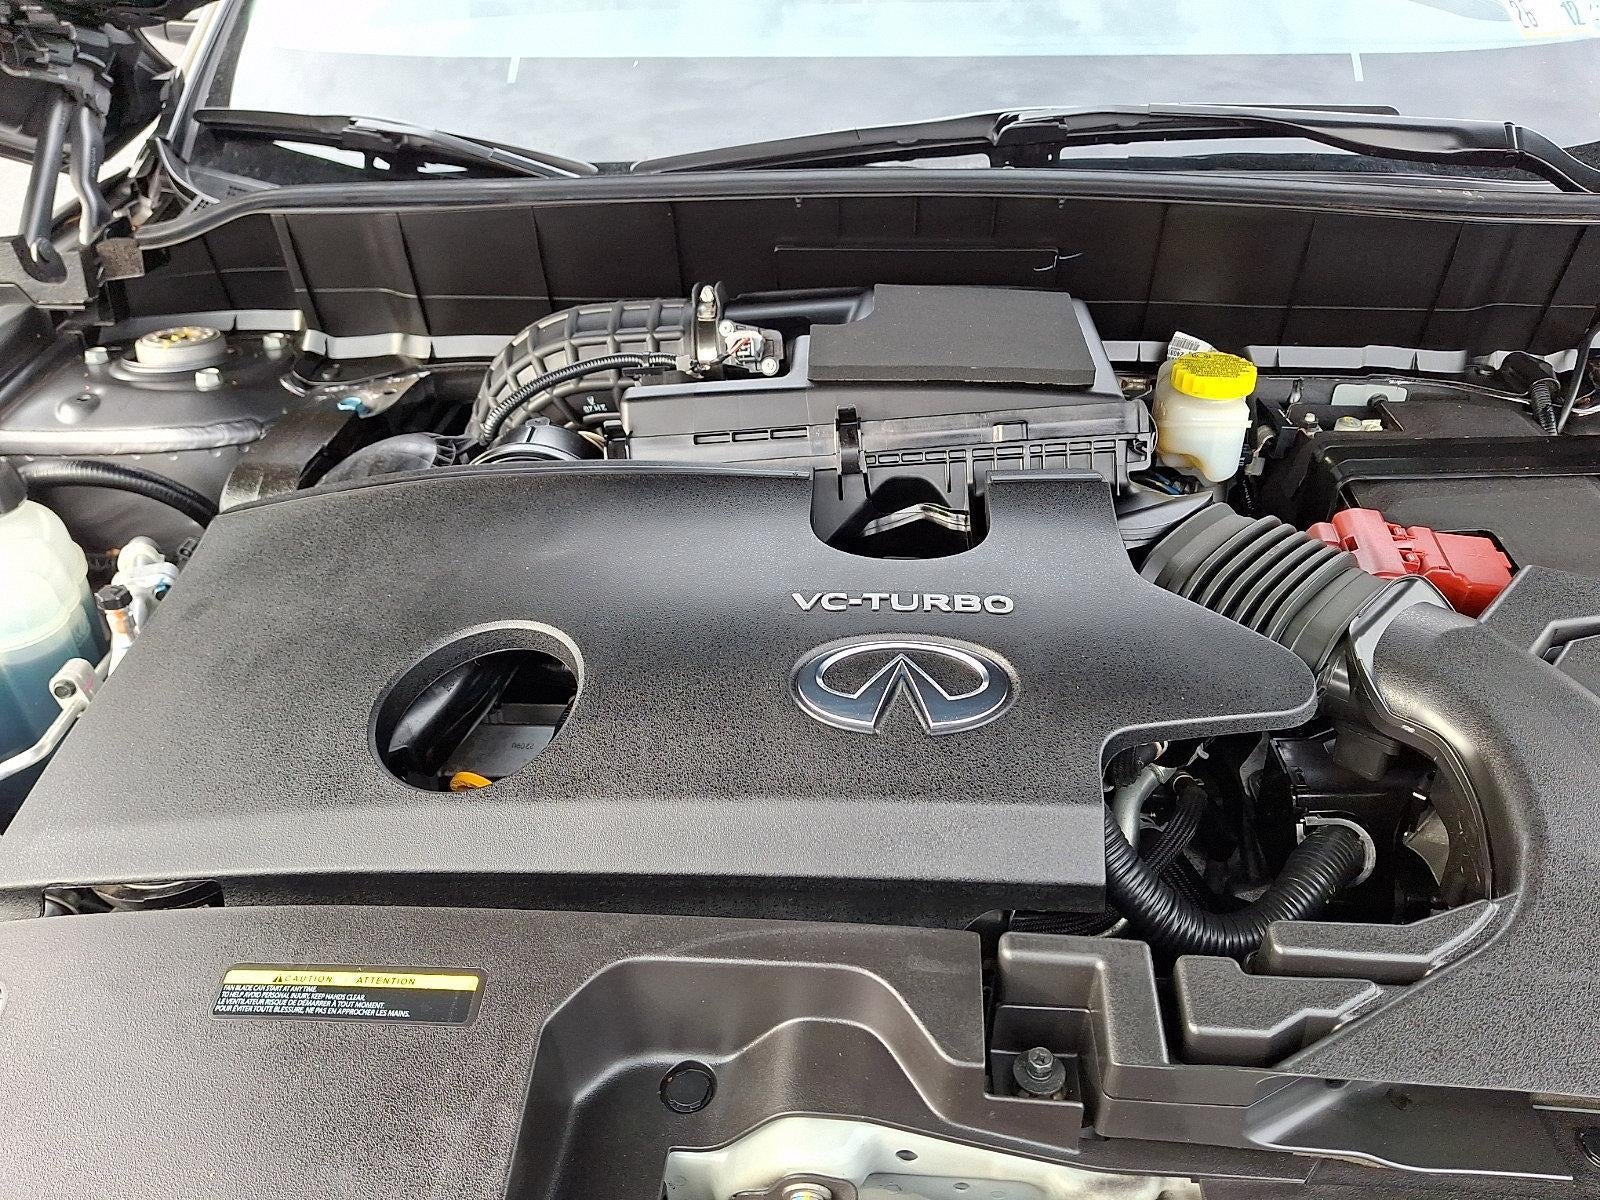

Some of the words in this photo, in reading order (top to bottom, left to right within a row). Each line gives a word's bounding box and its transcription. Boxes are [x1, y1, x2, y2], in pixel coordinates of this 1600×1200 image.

[792, 592, 1014, 614] VC-TURBO
[284, 974, 333, 983] CAUTION
[356, 976, 416, 985] ATTENTION
[264, 998, 288, 1006] RISQUE
[297, 999, 331, 1007] DÉMARRER
